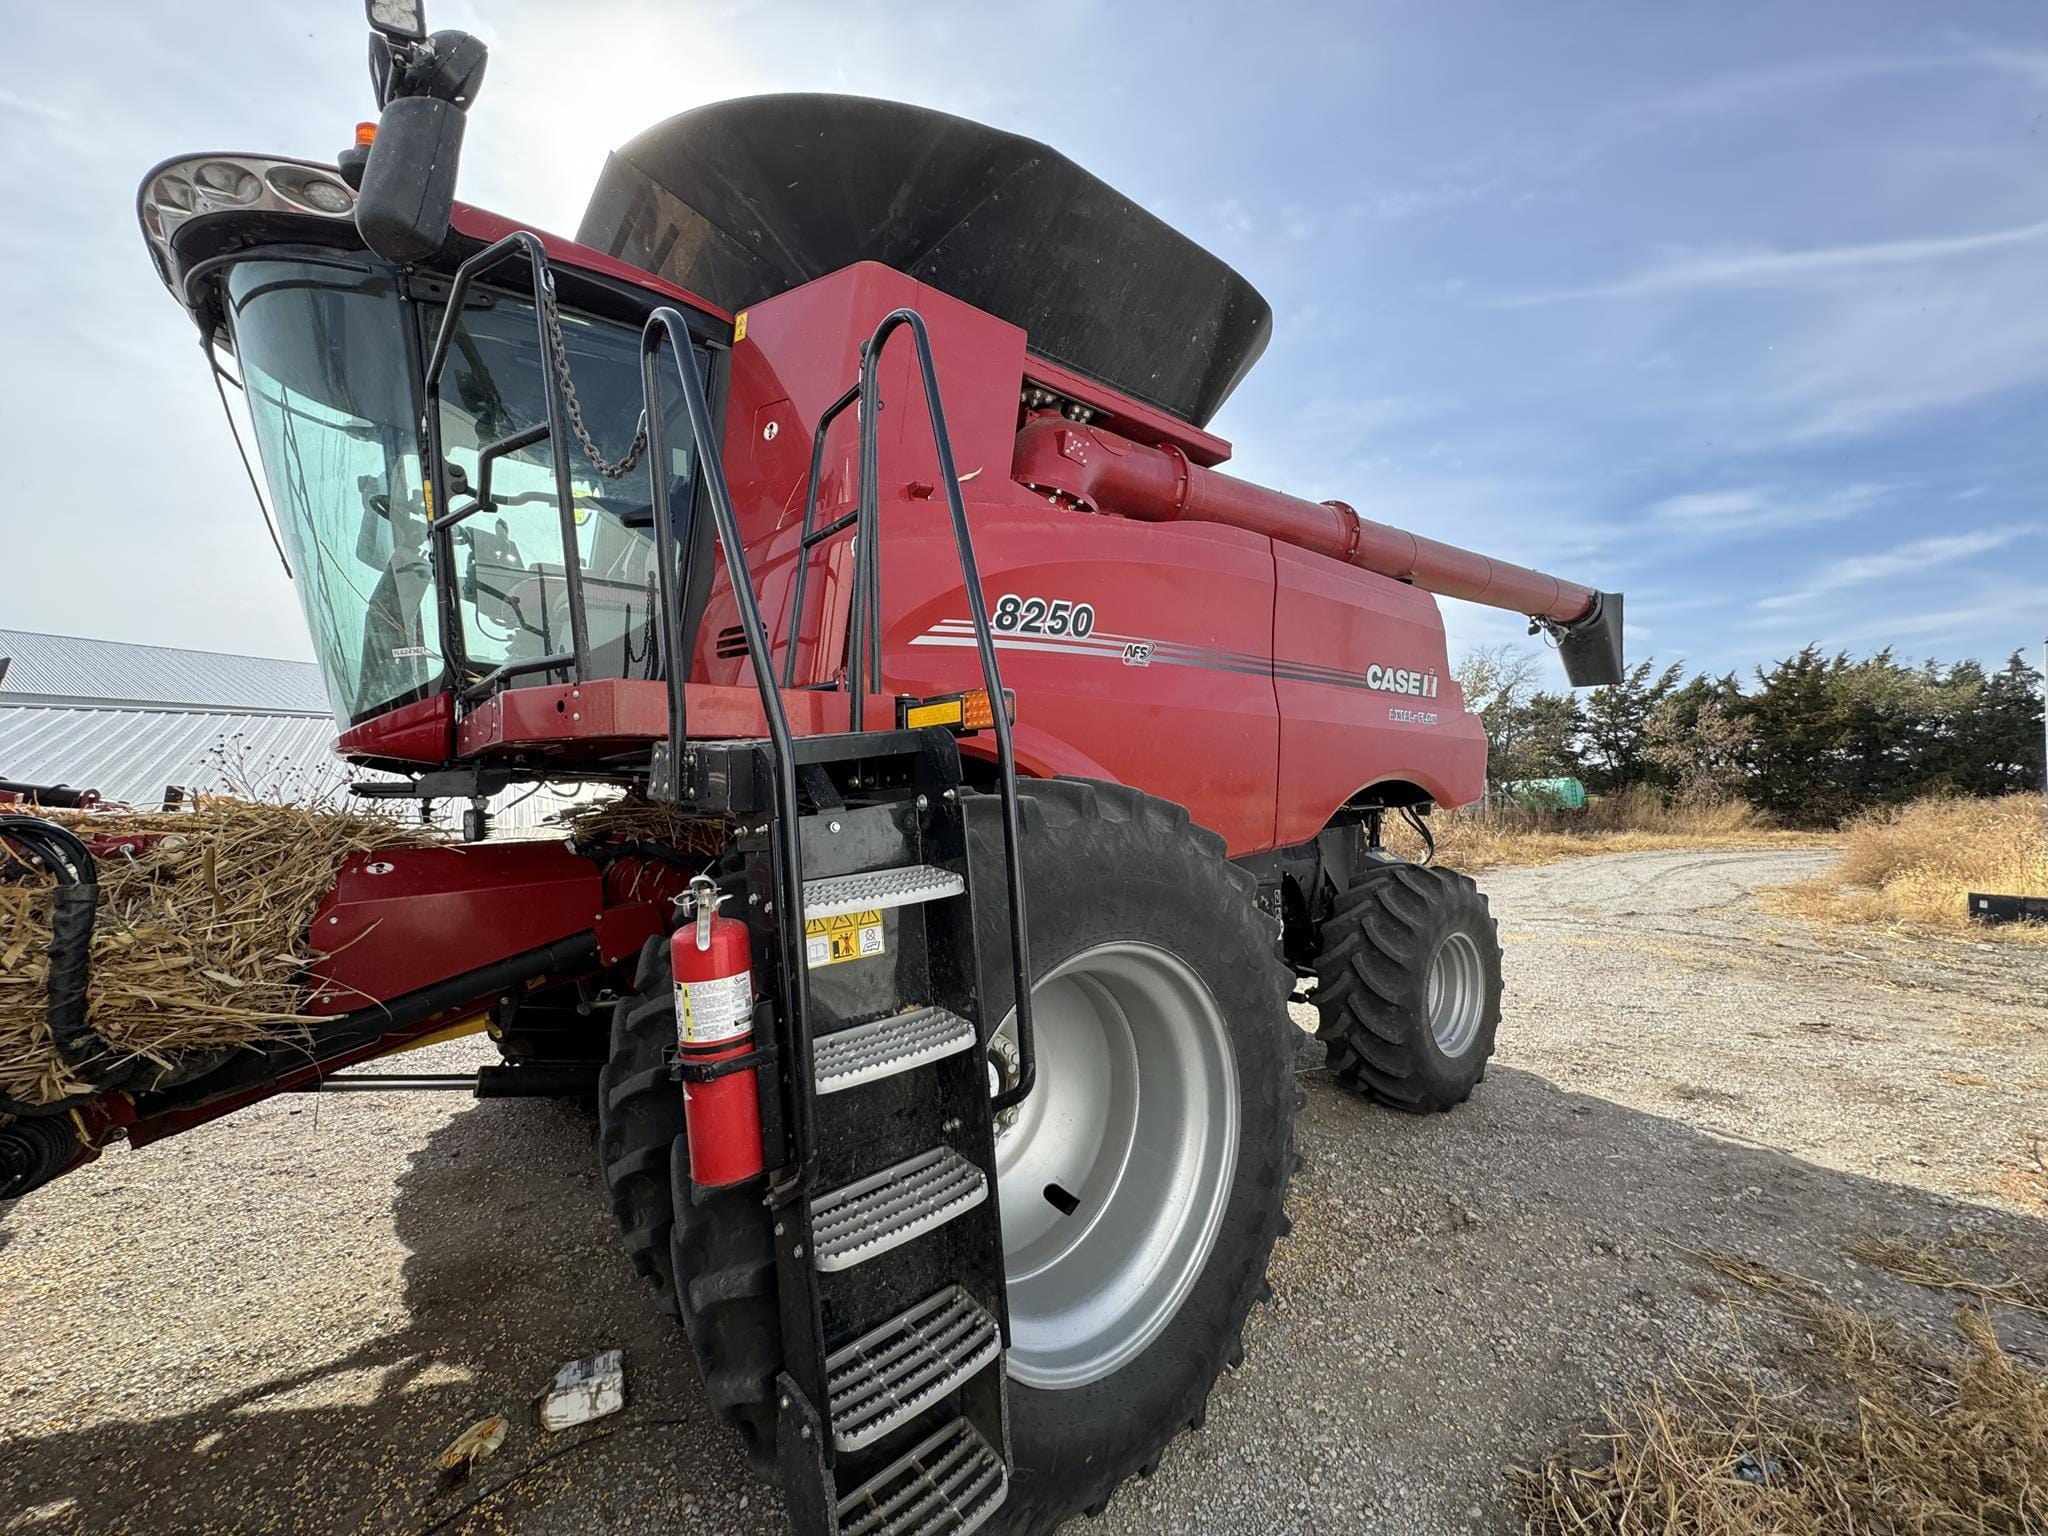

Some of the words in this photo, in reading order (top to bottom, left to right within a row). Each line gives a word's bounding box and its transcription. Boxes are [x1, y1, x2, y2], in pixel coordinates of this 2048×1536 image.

[993, 594, 1095, 639] 8250
[1123, 642, 1149, 659] AFS
[1366, 664, 1421, 696] CASE
